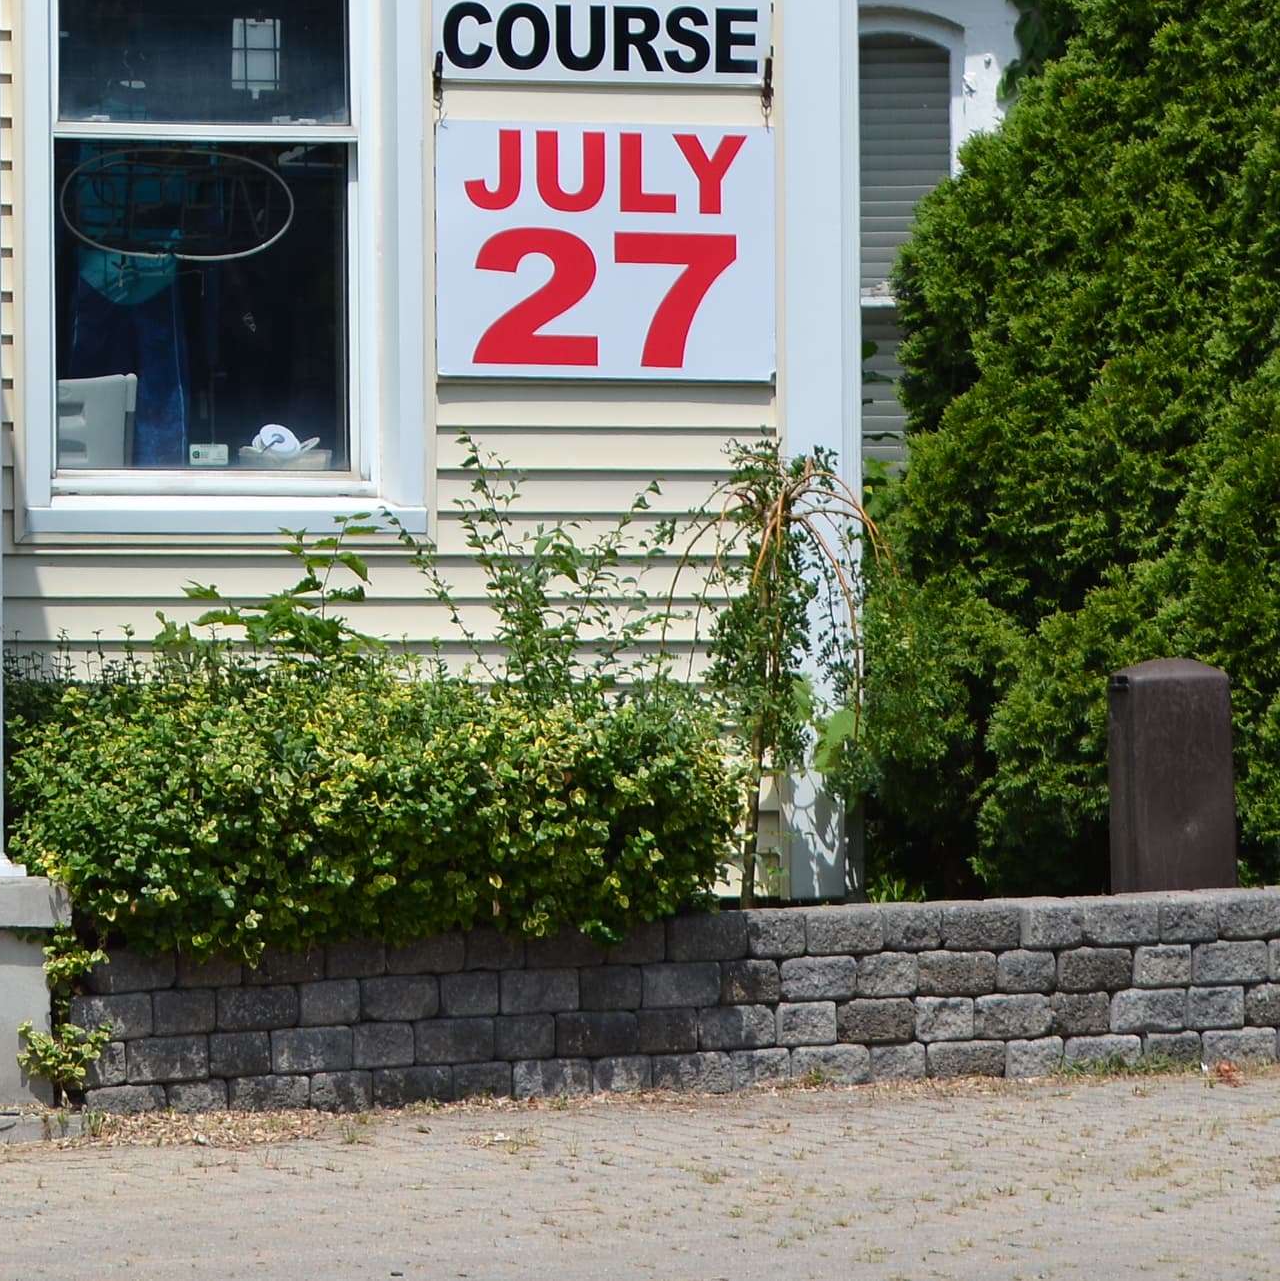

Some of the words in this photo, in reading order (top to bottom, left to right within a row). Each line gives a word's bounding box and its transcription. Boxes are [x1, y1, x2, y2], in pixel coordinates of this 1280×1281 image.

[442, 1, 759, 74] COURSE
[463, 128, 748, 215] JULY
[472, 226, 737, 369] 27
